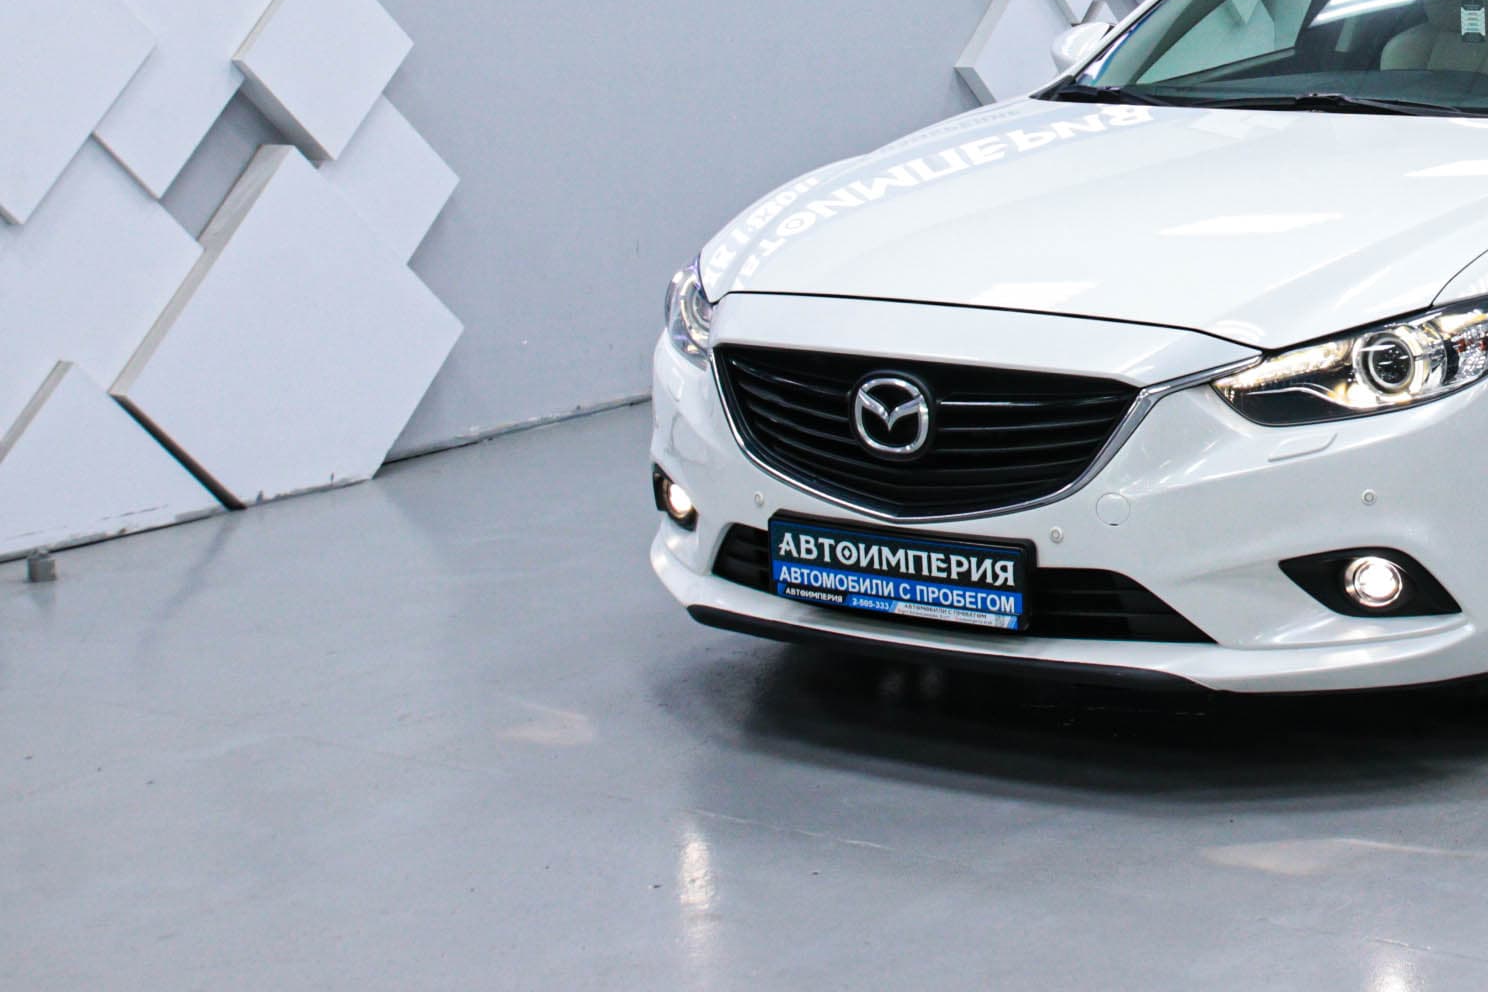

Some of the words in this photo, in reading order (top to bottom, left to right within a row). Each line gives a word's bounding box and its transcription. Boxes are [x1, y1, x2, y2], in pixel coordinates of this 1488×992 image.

[778, 532, 1015, 586] АВТОИМПЕРИЯ
[779, 565, 895, 598] АВТОМОБИЛИ
[899, 583, 911, 598] С
[916, 585, 1015, 613] ПРОБЕГОМ
[785, 588, 843, 603] АВТОИМПЕРИЯ
